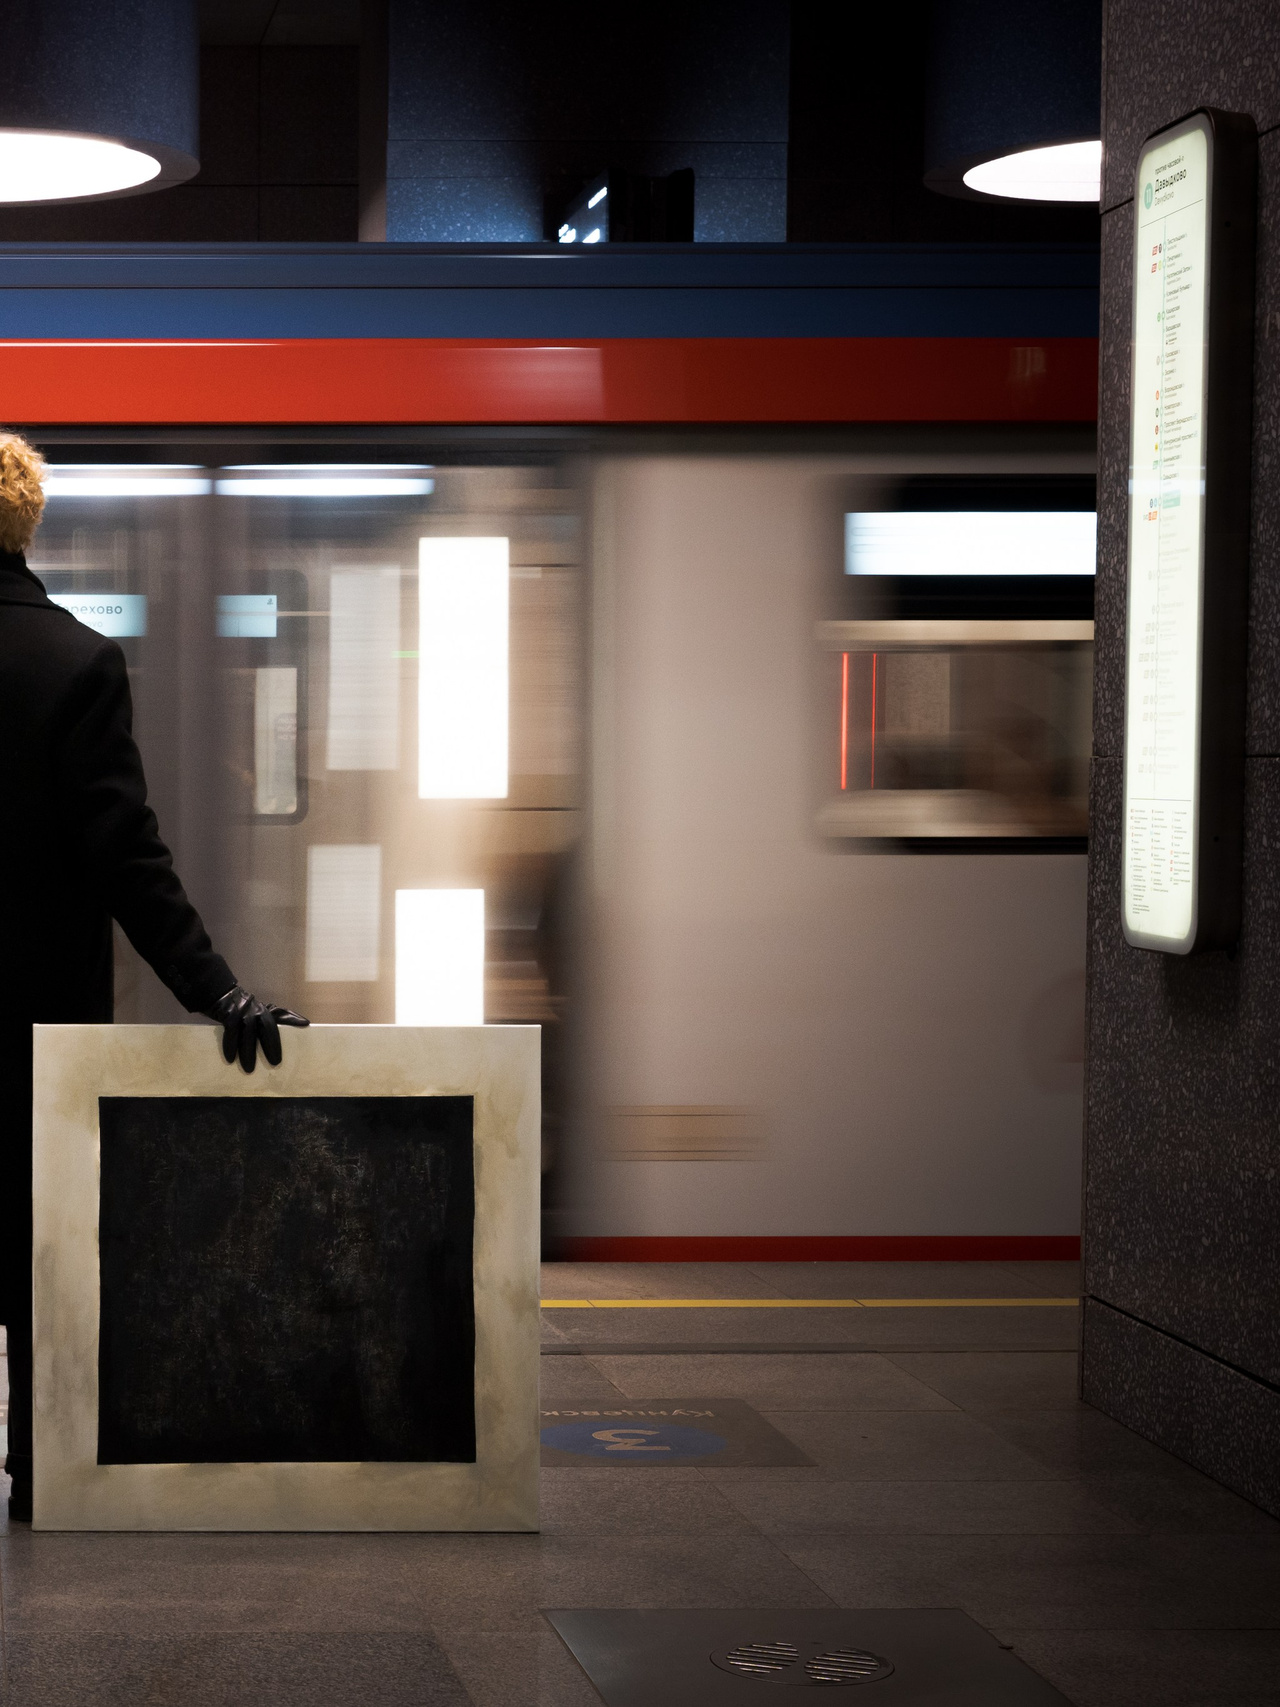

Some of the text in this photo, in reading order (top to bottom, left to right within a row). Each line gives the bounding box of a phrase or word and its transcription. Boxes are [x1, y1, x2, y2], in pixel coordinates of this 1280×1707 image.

[1155, 168, 1187, 193] Давыдково
[57, 603, 123, 615] рехово
[540, 1408, 715, 1418] Кунцевск
[591, 1429, 672, 1451] 3
